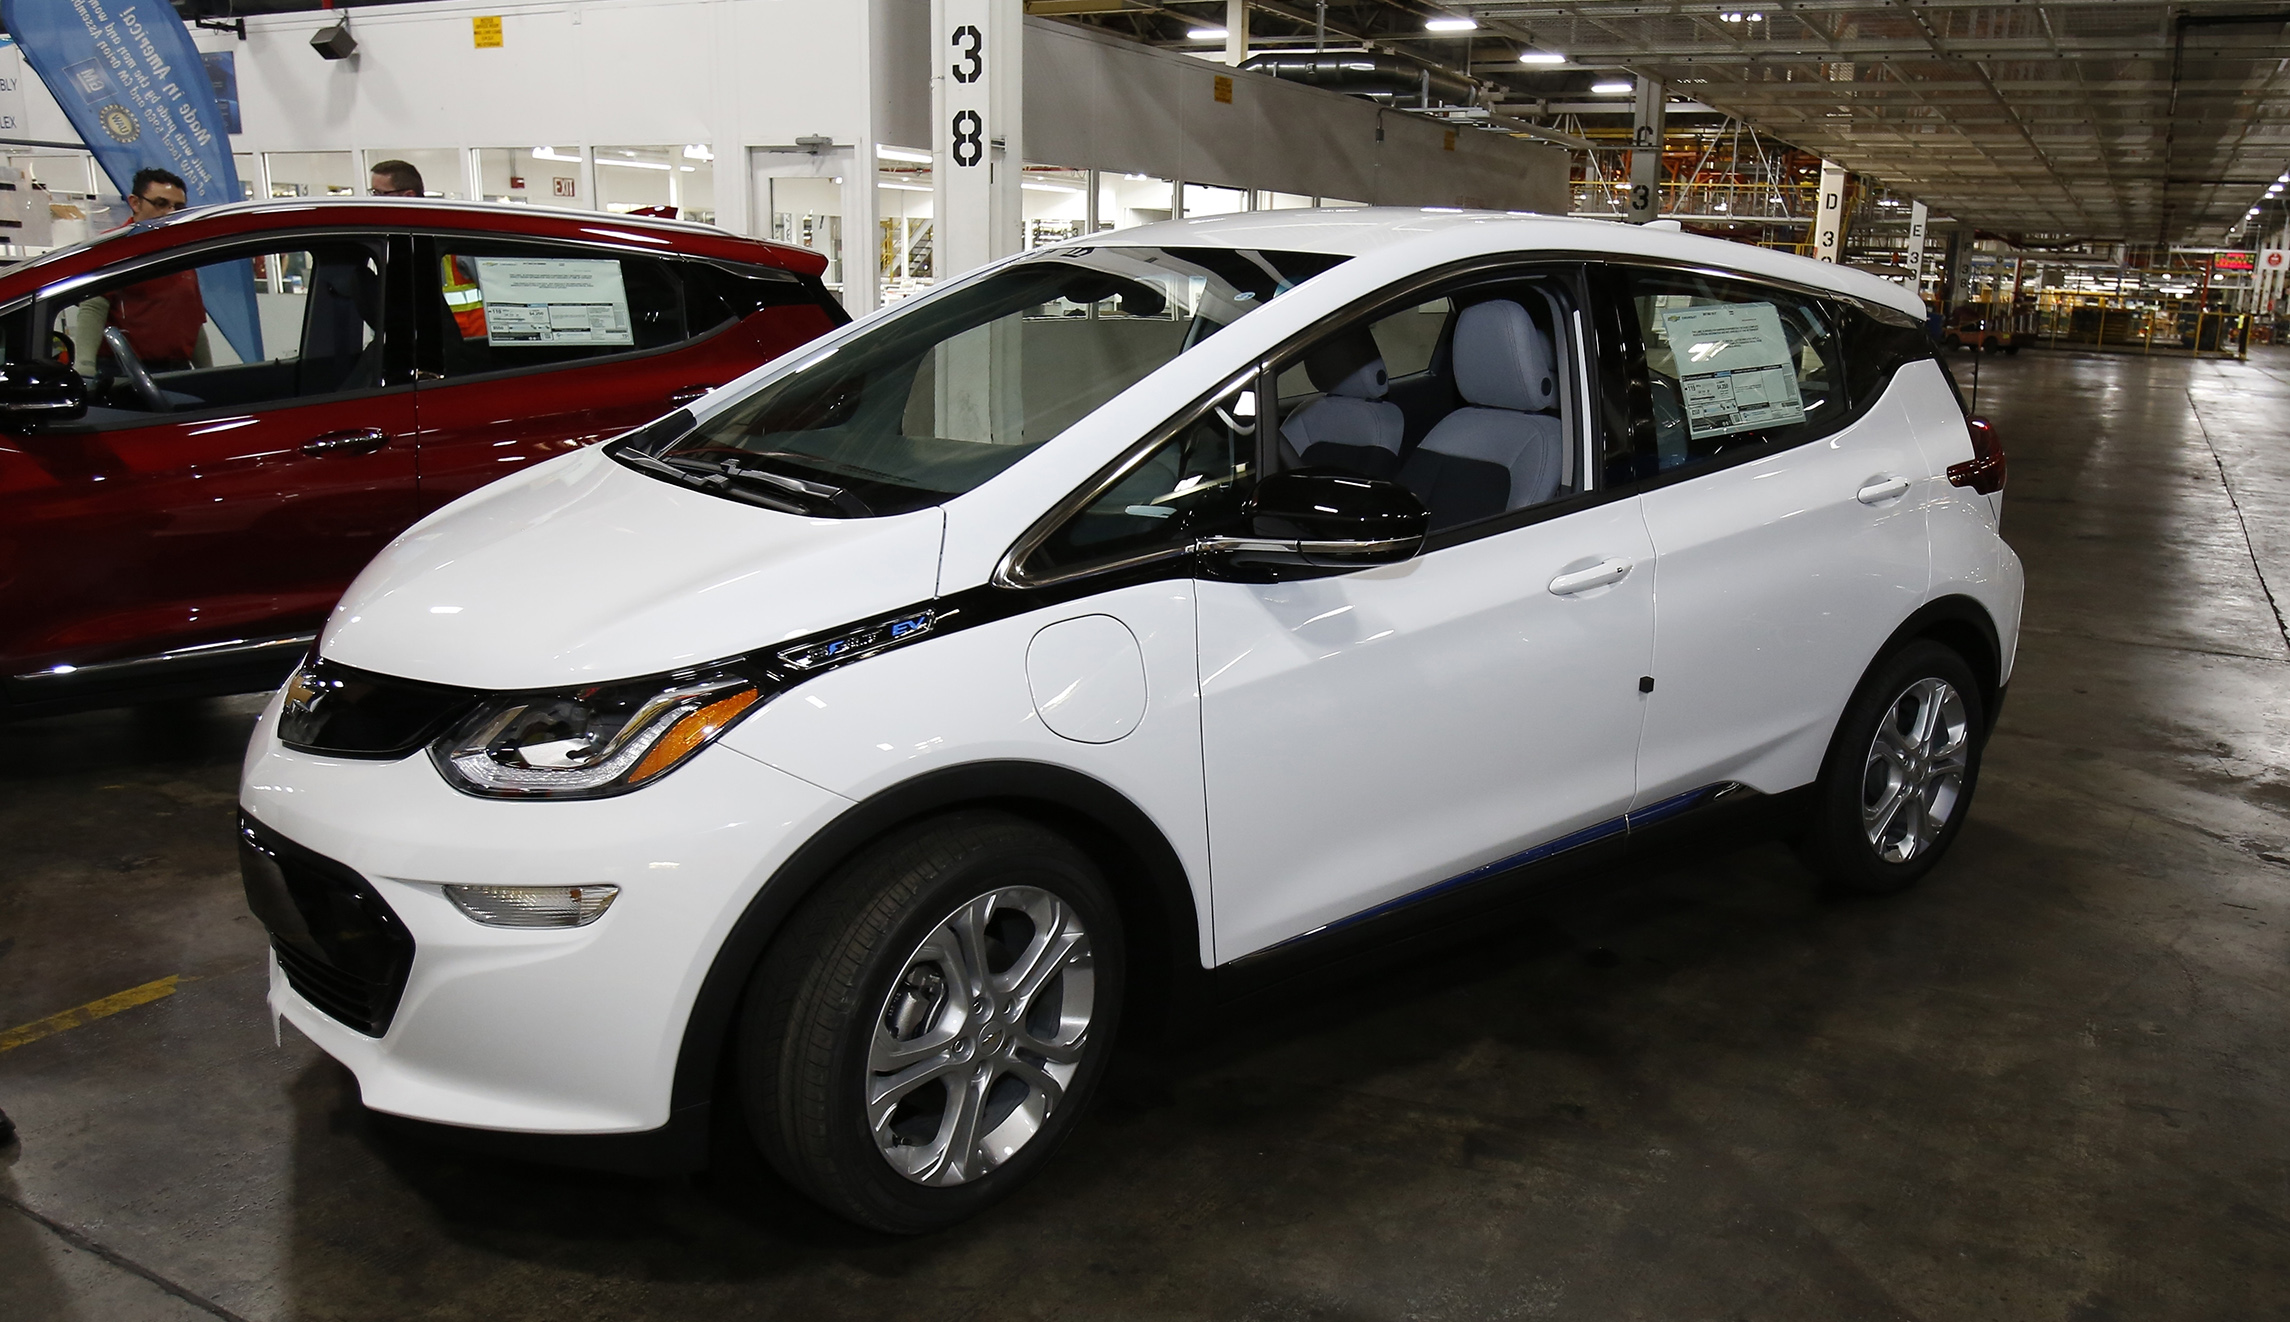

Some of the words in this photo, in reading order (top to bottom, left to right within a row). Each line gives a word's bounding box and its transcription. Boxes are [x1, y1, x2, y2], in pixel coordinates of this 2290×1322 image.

[553, 178, 575, 196] EXIT
[1825, 193, 1838, 210] D
[1912, 224, 1923, 237] E
[891, 616, 926, 637] EV
